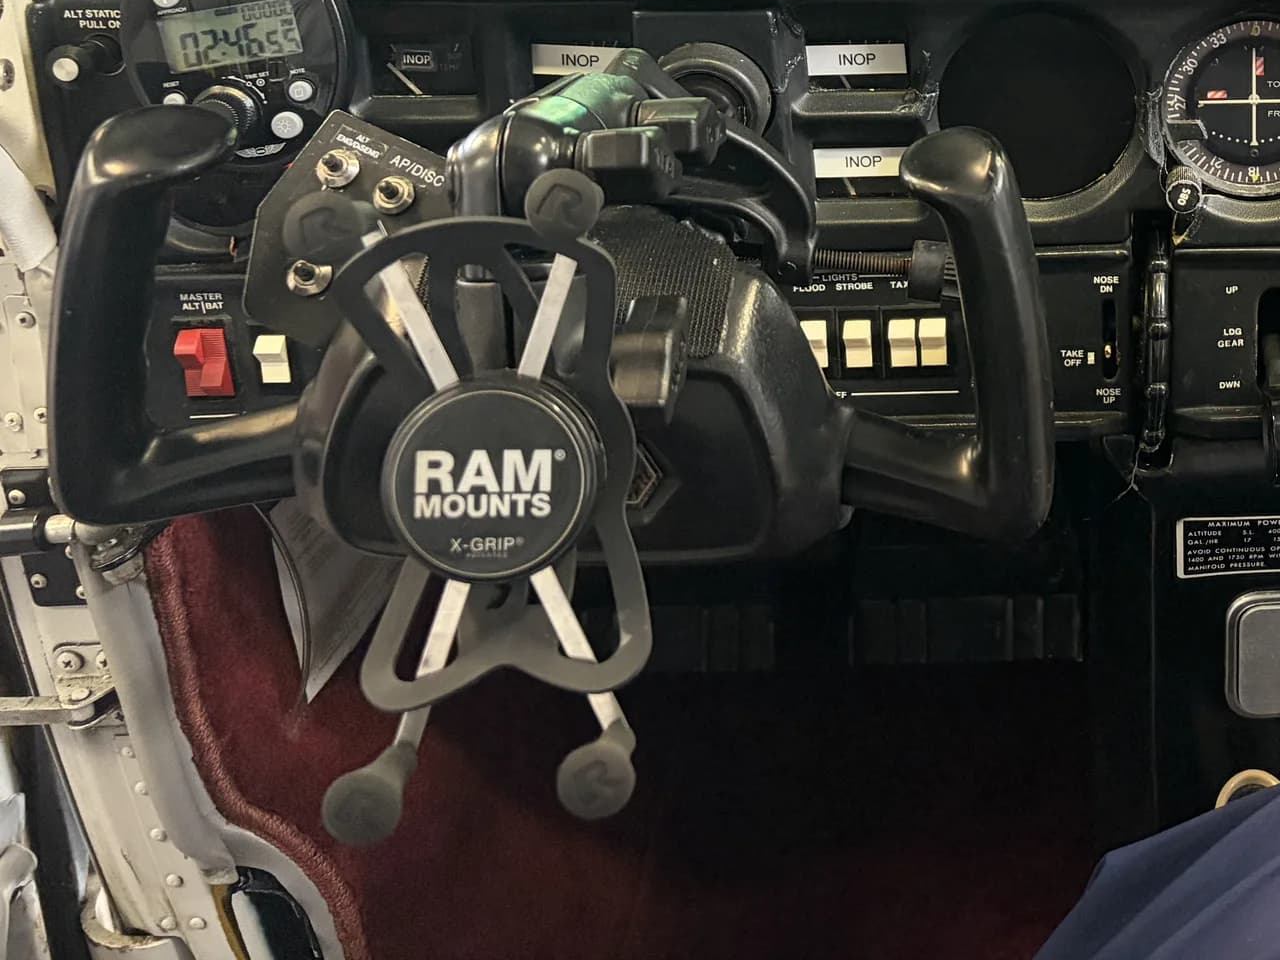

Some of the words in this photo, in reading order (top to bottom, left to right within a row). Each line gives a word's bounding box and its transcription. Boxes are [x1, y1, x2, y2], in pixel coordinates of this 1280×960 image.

[402, 53, 431, 65] INOP
[561, 53, 600, 67] INOP
[838, 53, 876, 66] INOP
[1267, 80, 1280, 88] TO
[389, 154, 446, 188] AP/DISC
[1177, 188, 1192, 206] OBS
[822, 274, 858, 282] LIGHTS
[836, 282, 873, 290] STROBE
[1226, 285, 1238, 294] UP
[180, 293, 223, 301] MASTER
[1223, 328, 1242, 336] LDG
[1217, 339, 1244, 348] GEAR
[1060, 350, 1084, 358] TAKE
[1064, 358, 1082, 367] OFF
[1219, 381, 1240, 389] DWN
[1096, 388, 1121, 397] NOSE
[415, 449, 552, 493] RAM
[414, 493, 551, 519] MOUNTS
[450, 537, 515, 552] X-GRIP
